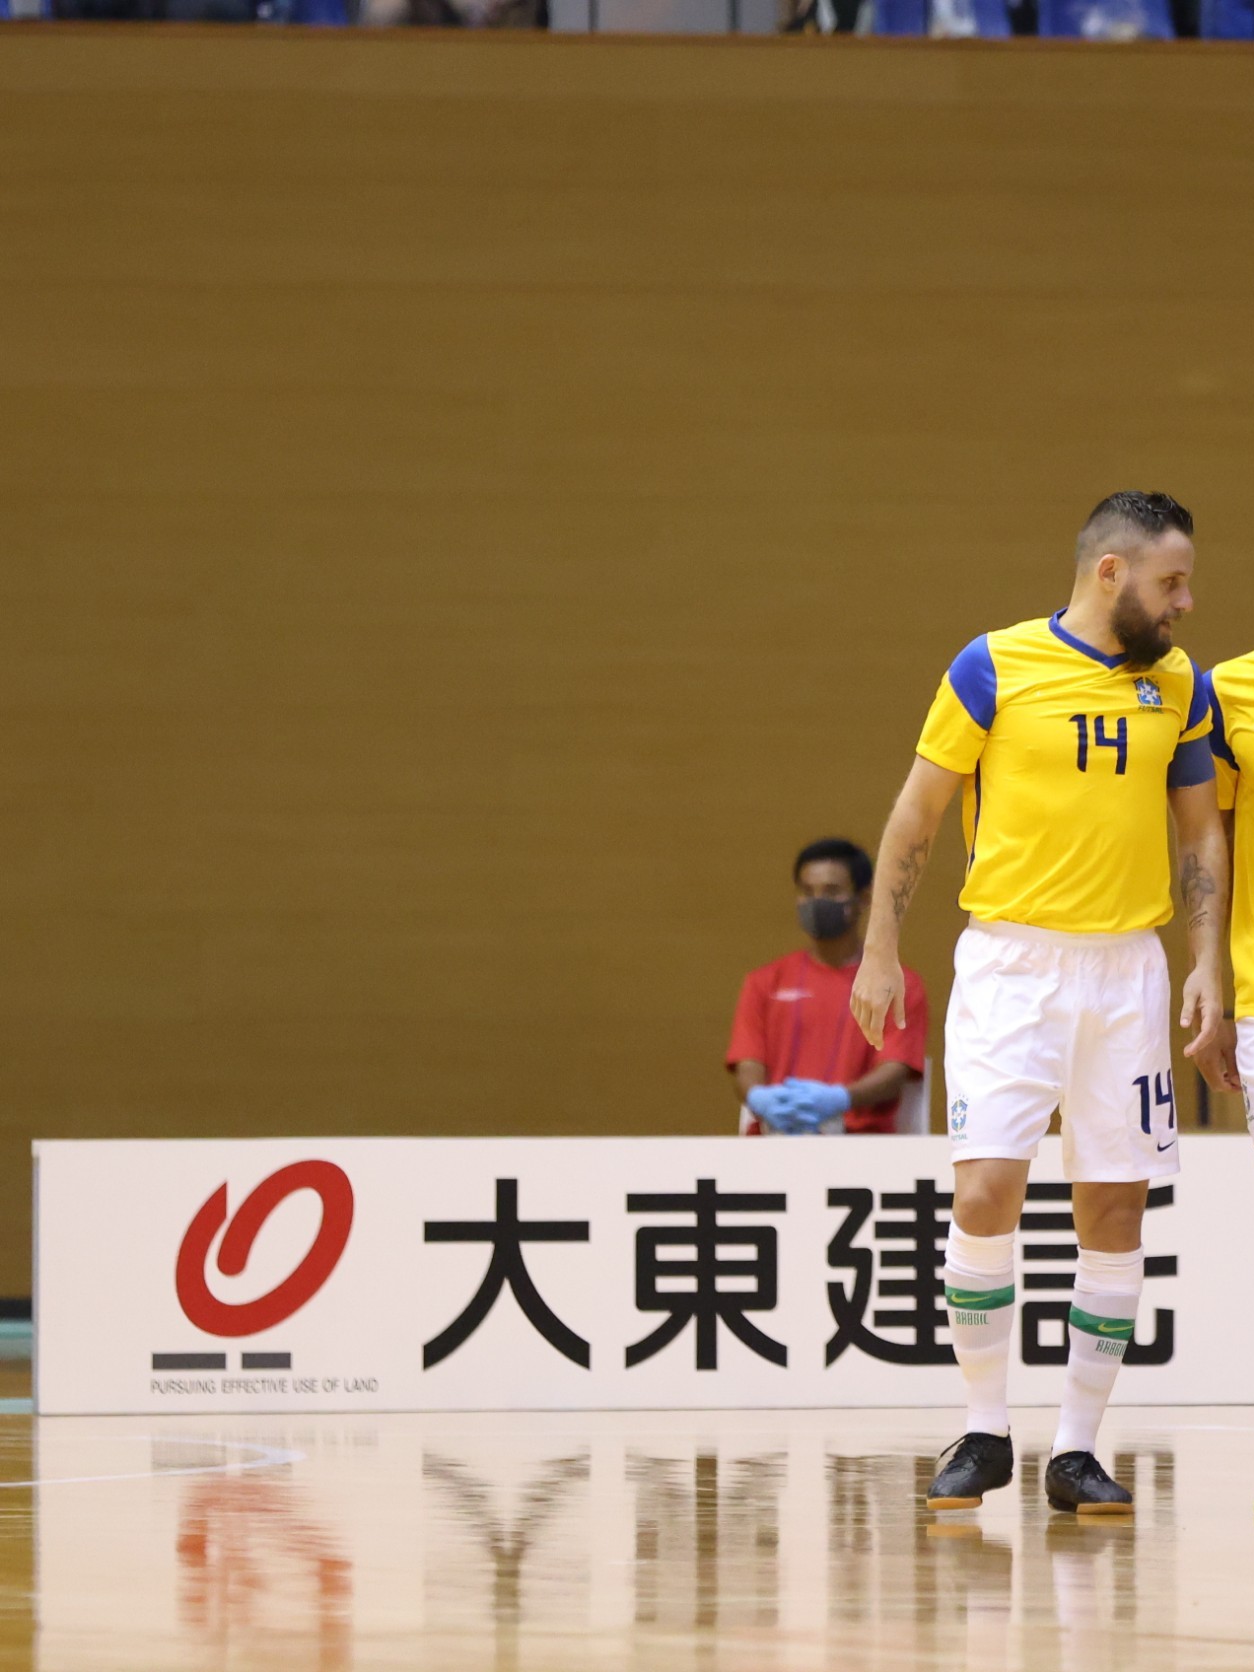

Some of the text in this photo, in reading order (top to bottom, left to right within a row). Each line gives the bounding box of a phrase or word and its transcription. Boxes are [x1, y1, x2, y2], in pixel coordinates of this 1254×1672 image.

[1069, 714, 1128, 775] 14
[1132, 1068, 1174, 1135] 14
[151, 1377, 379, 1394] PURSUING EFFECTIVE USE OF LAND
